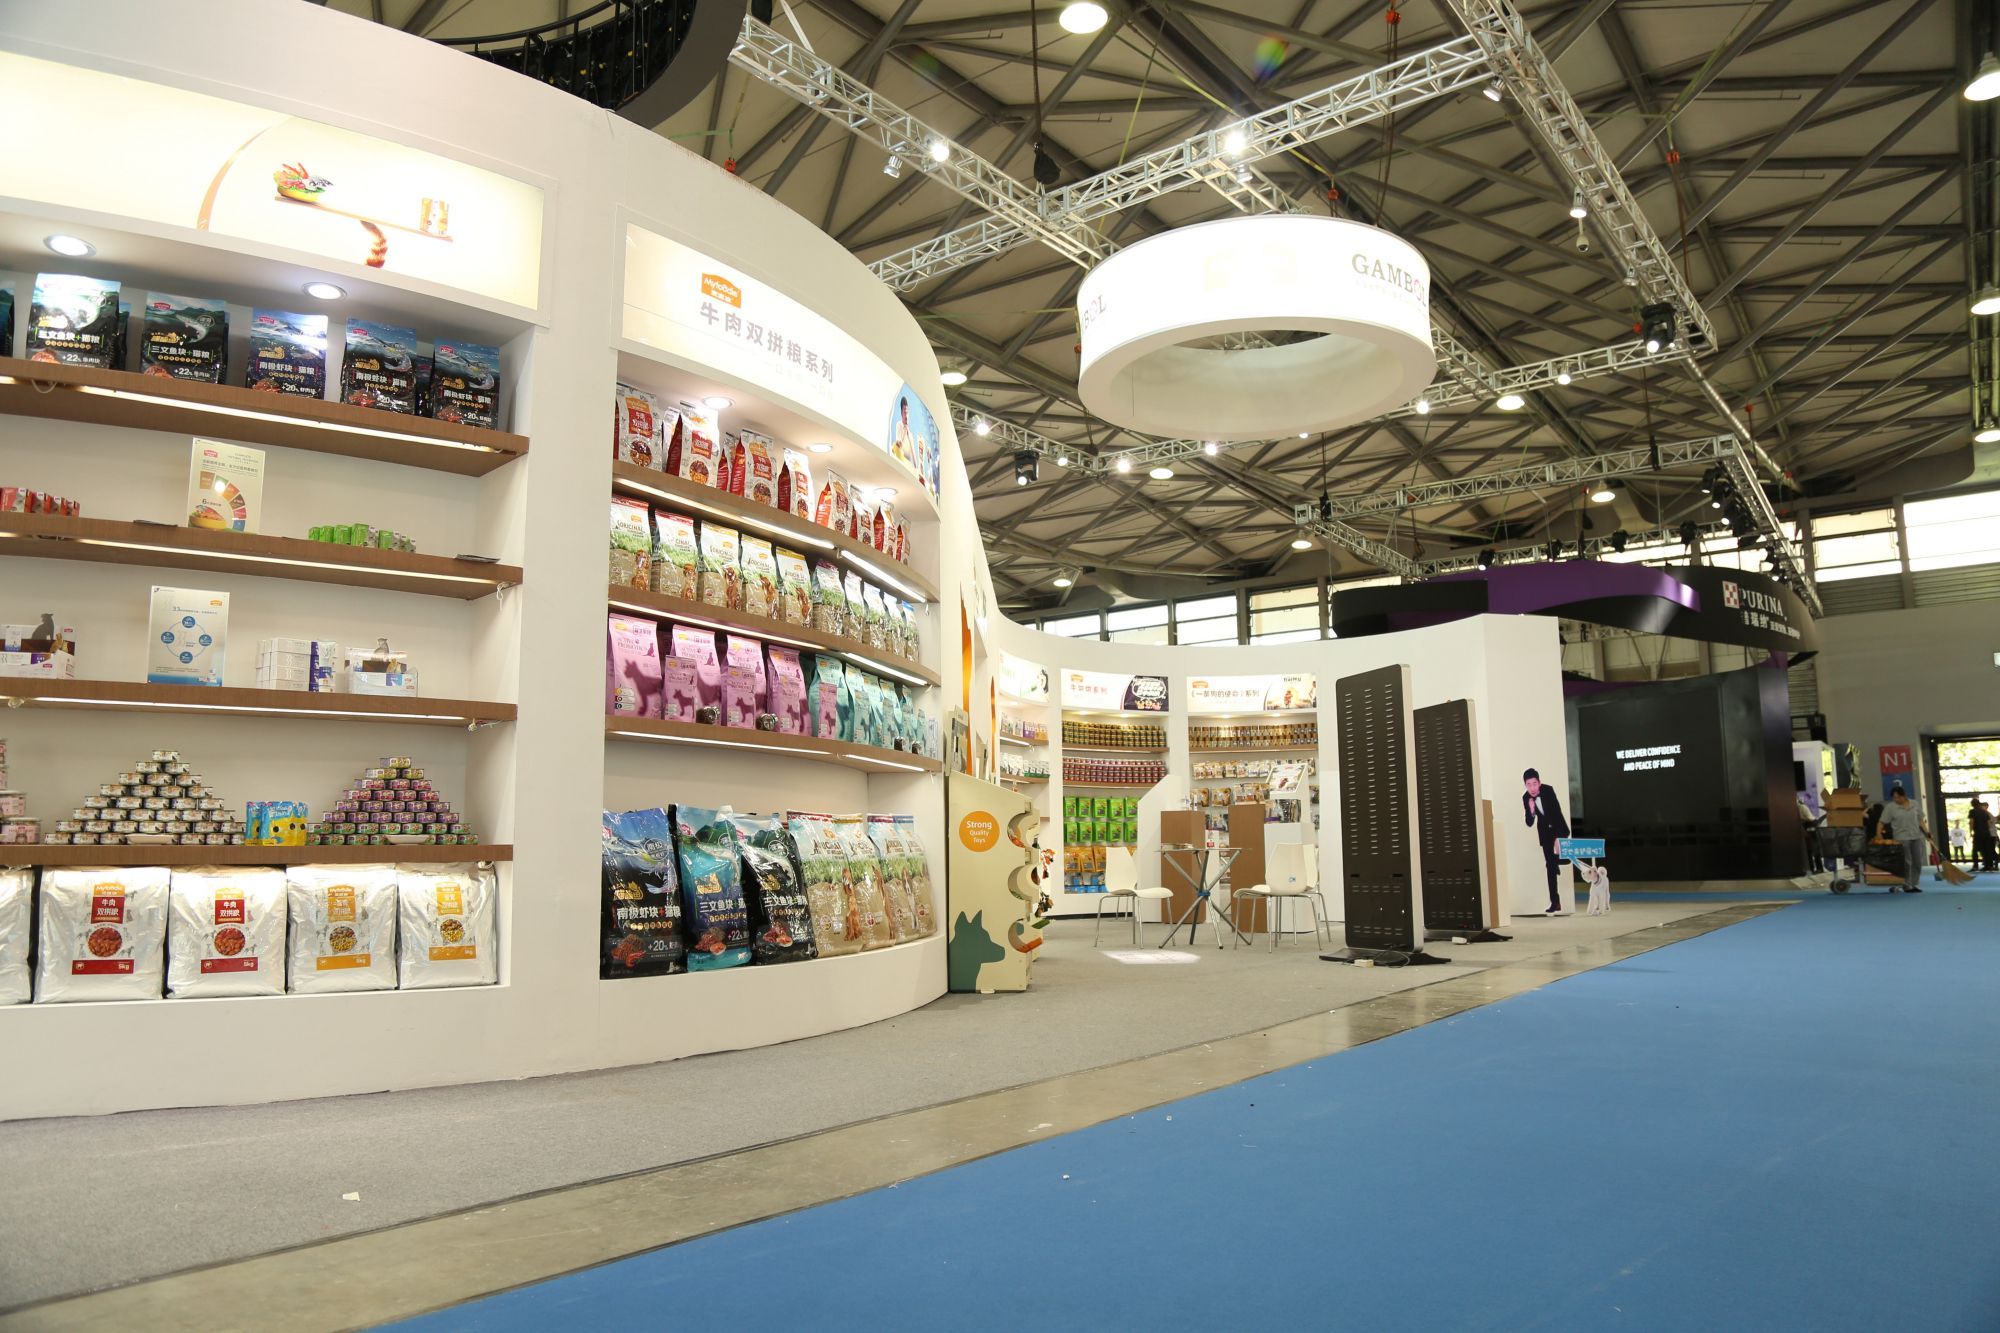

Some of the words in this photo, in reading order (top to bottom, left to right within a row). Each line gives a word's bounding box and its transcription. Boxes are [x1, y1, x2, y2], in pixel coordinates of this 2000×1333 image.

[1352, 253, 1426, 307] GAMBOL
[700, 301, 834, 383] 牛肉双拼粮系列
[1616, 750, 1625, 759] WE
[1625, 748, 1647, 758] DELIVER
[1647, 745, 1681, 757] CONFIDENCE
[1884, 752, 1907, 767] N1
[1623, 762, 1635, 771] AND
[1635, 761, 1652, 770] PEACE
[1652, 760, 1660, 769] OF
[1660, 759, 1675, 768] MIND
[966, 821, 993, 830] Strong
[969, 829, 990, 837] Quality
[101, 899, 116, 907] 牛肉
[223, 901, 237, 909] 牛肉
[96, 908, 119, 916] 双拼粮
